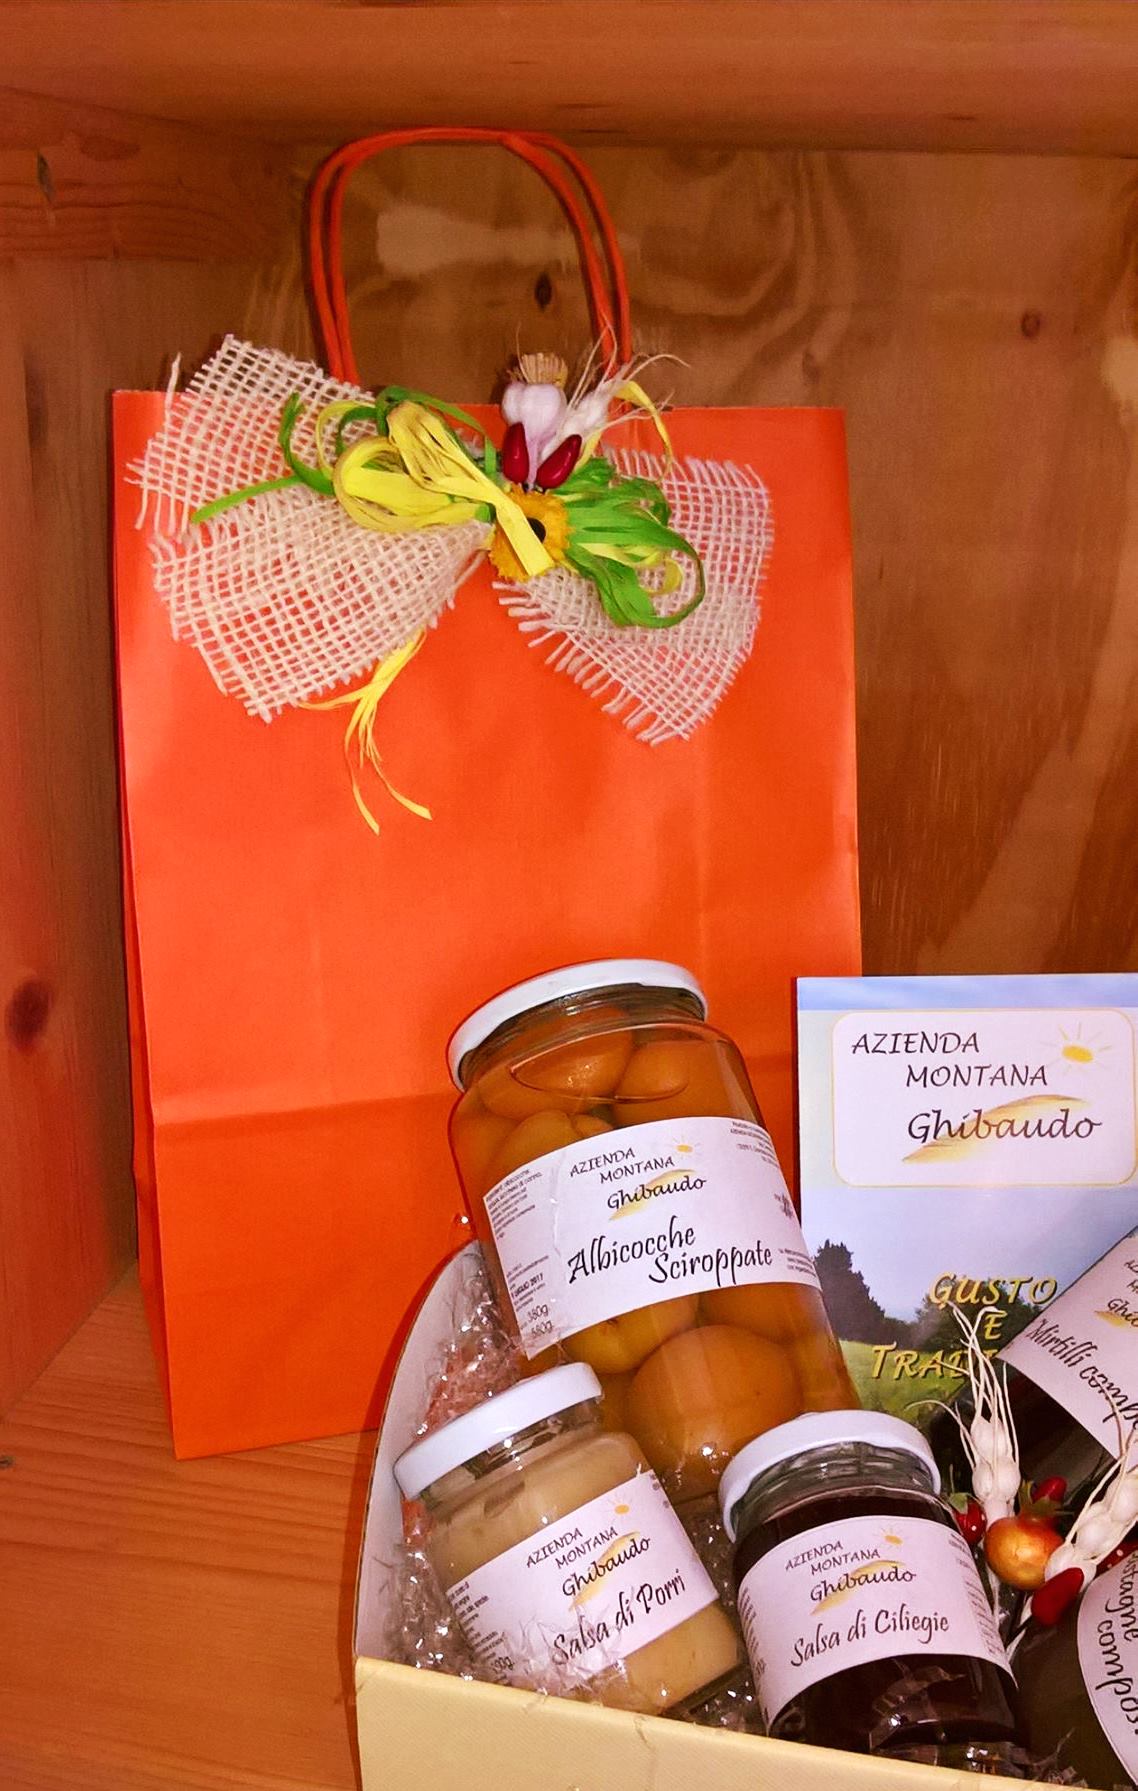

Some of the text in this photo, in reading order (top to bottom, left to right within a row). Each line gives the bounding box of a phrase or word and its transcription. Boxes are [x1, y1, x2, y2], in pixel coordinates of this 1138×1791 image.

[851, 1031, 981, 1055] AZIENDA
[906, 1063, 1049, 1088] MONTANA
[907, 1109, 1103, 1143] Ghibaudo
[569, 1147, 636, 1177] AZIENDA
[599, 1156, 675, 1184] MONTANA
[607, 1175, 707, 1209] Ghibaudo
[568, 1215, 697, 1284] Albicocche
[648, 1240, 773, 1287] Sciroppate
[929, 1271, 1060, 1309] GUSTO
[983, 1309, 1008, 1341] E
[871, 1341, 998, 1380] TRAD
[1025, 1318, 1138, 1431] Mirtilli comp
[526, 1527, 584, 1568] AZIENDA
[554, 1526, 619, 1570] MONTANA
[785, 1540, 844, 1571] AZIENDA
[810, 1548, 880, 1576] MONTANA
[562, 1537, 651, 1596] Ghibaudo
[810, 1566, 917, 1602] Ghibaudo
[551, 1614, 611, 1666] Salsa
[615, 1591, 636, 1631] di
[636, 1568, 686, 1614] Porri
[790, 1603, 950, 1667] Salsa di Ciliegie
